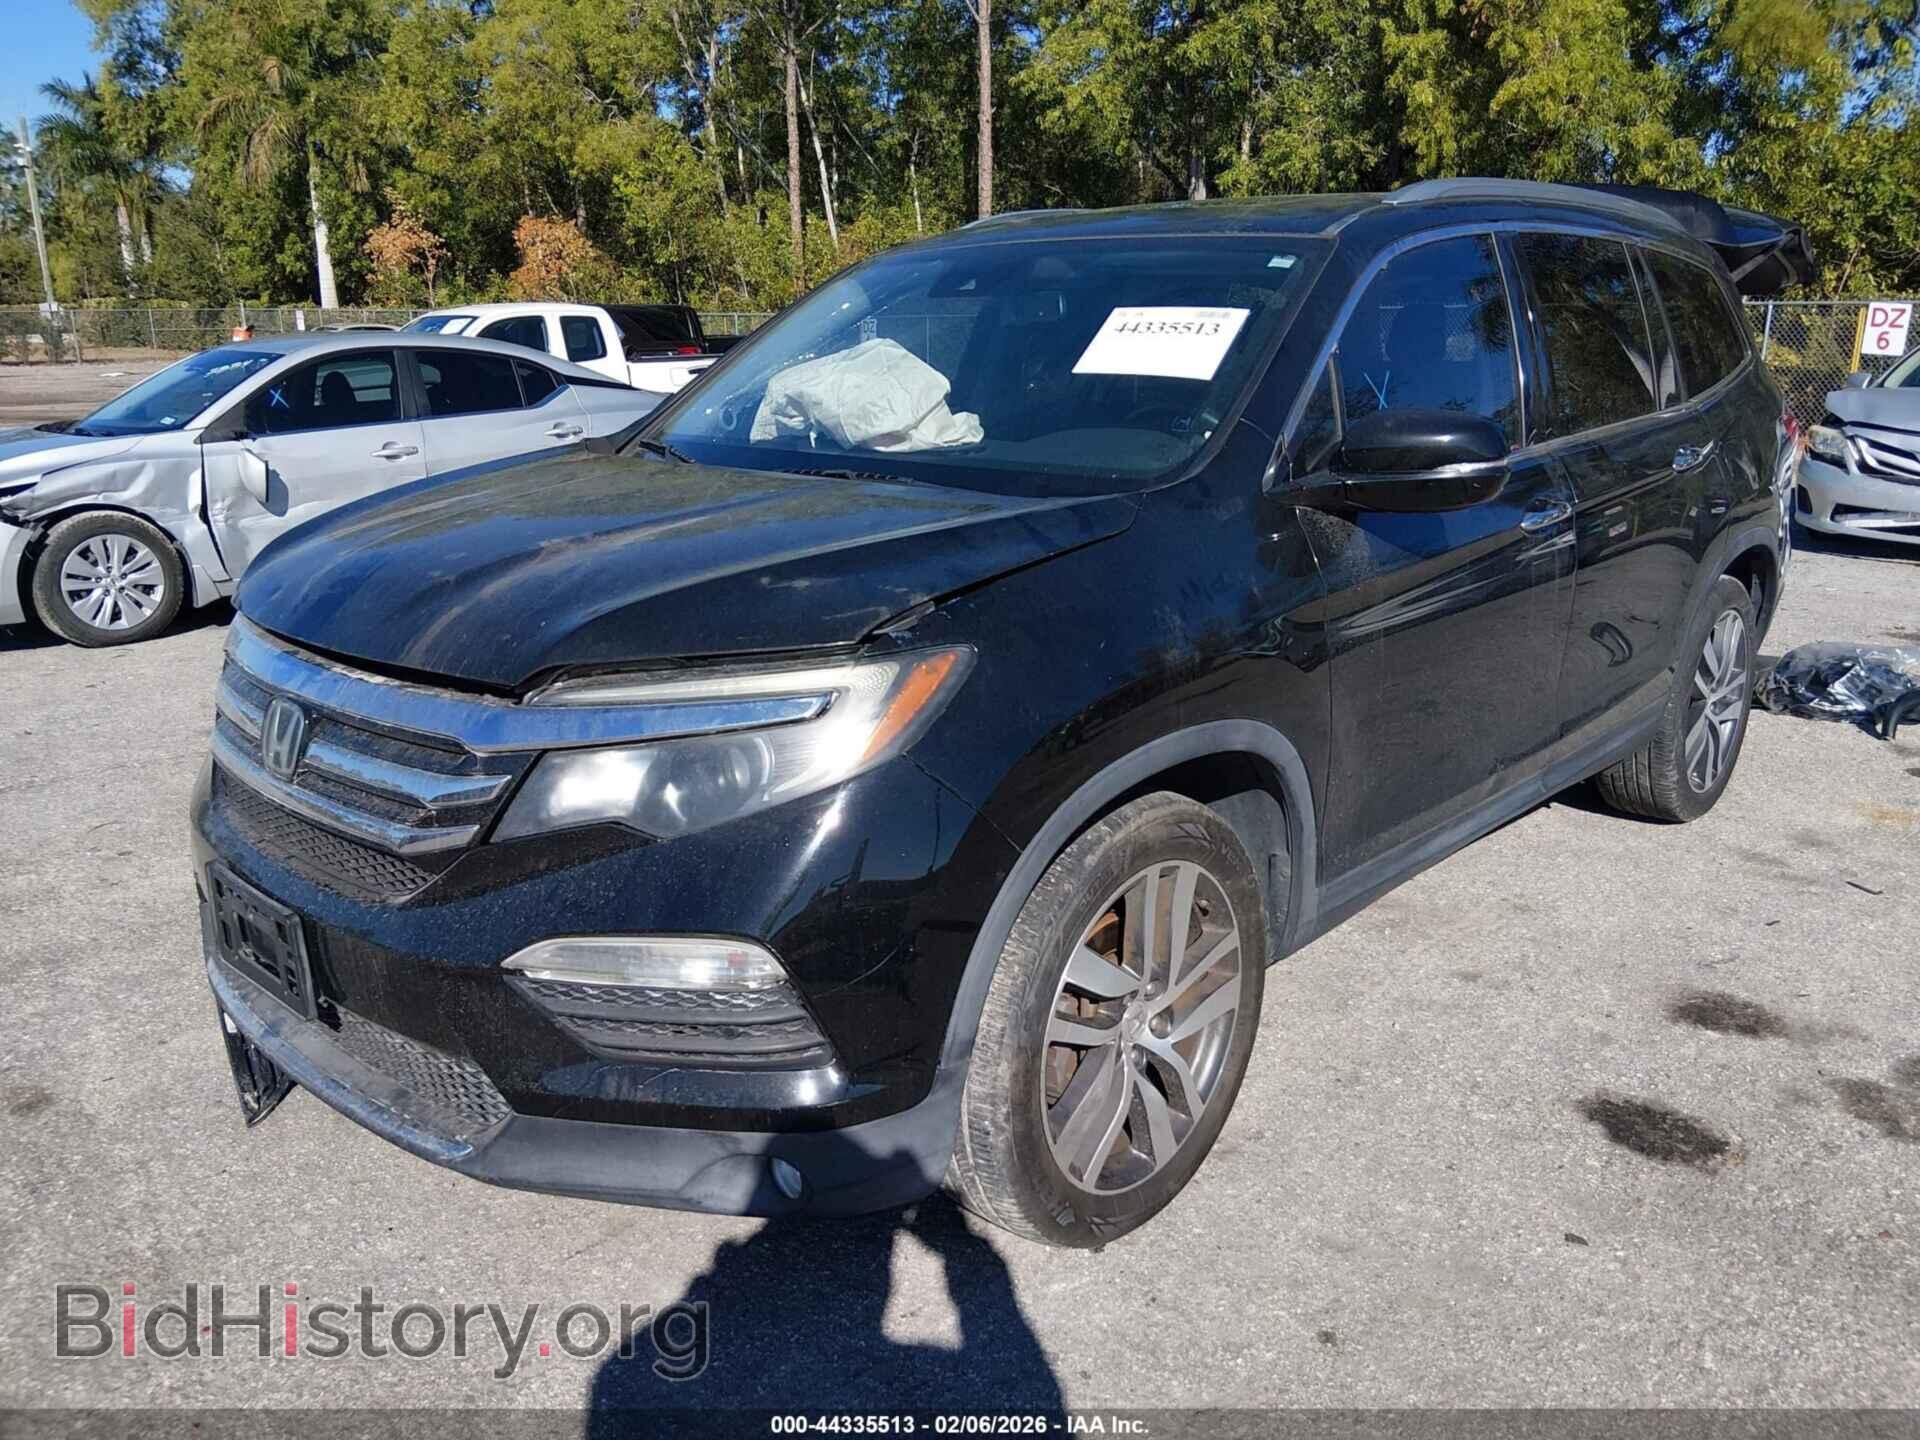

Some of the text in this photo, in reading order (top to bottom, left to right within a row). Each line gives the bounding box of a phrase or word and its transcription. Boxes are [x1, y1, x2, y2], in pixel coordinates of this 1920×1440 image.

[1870, 307, 1906, 328] DZ
[1114, 320, 1221, 336] 44335513
[1876, 331, 1890, 350] 6
